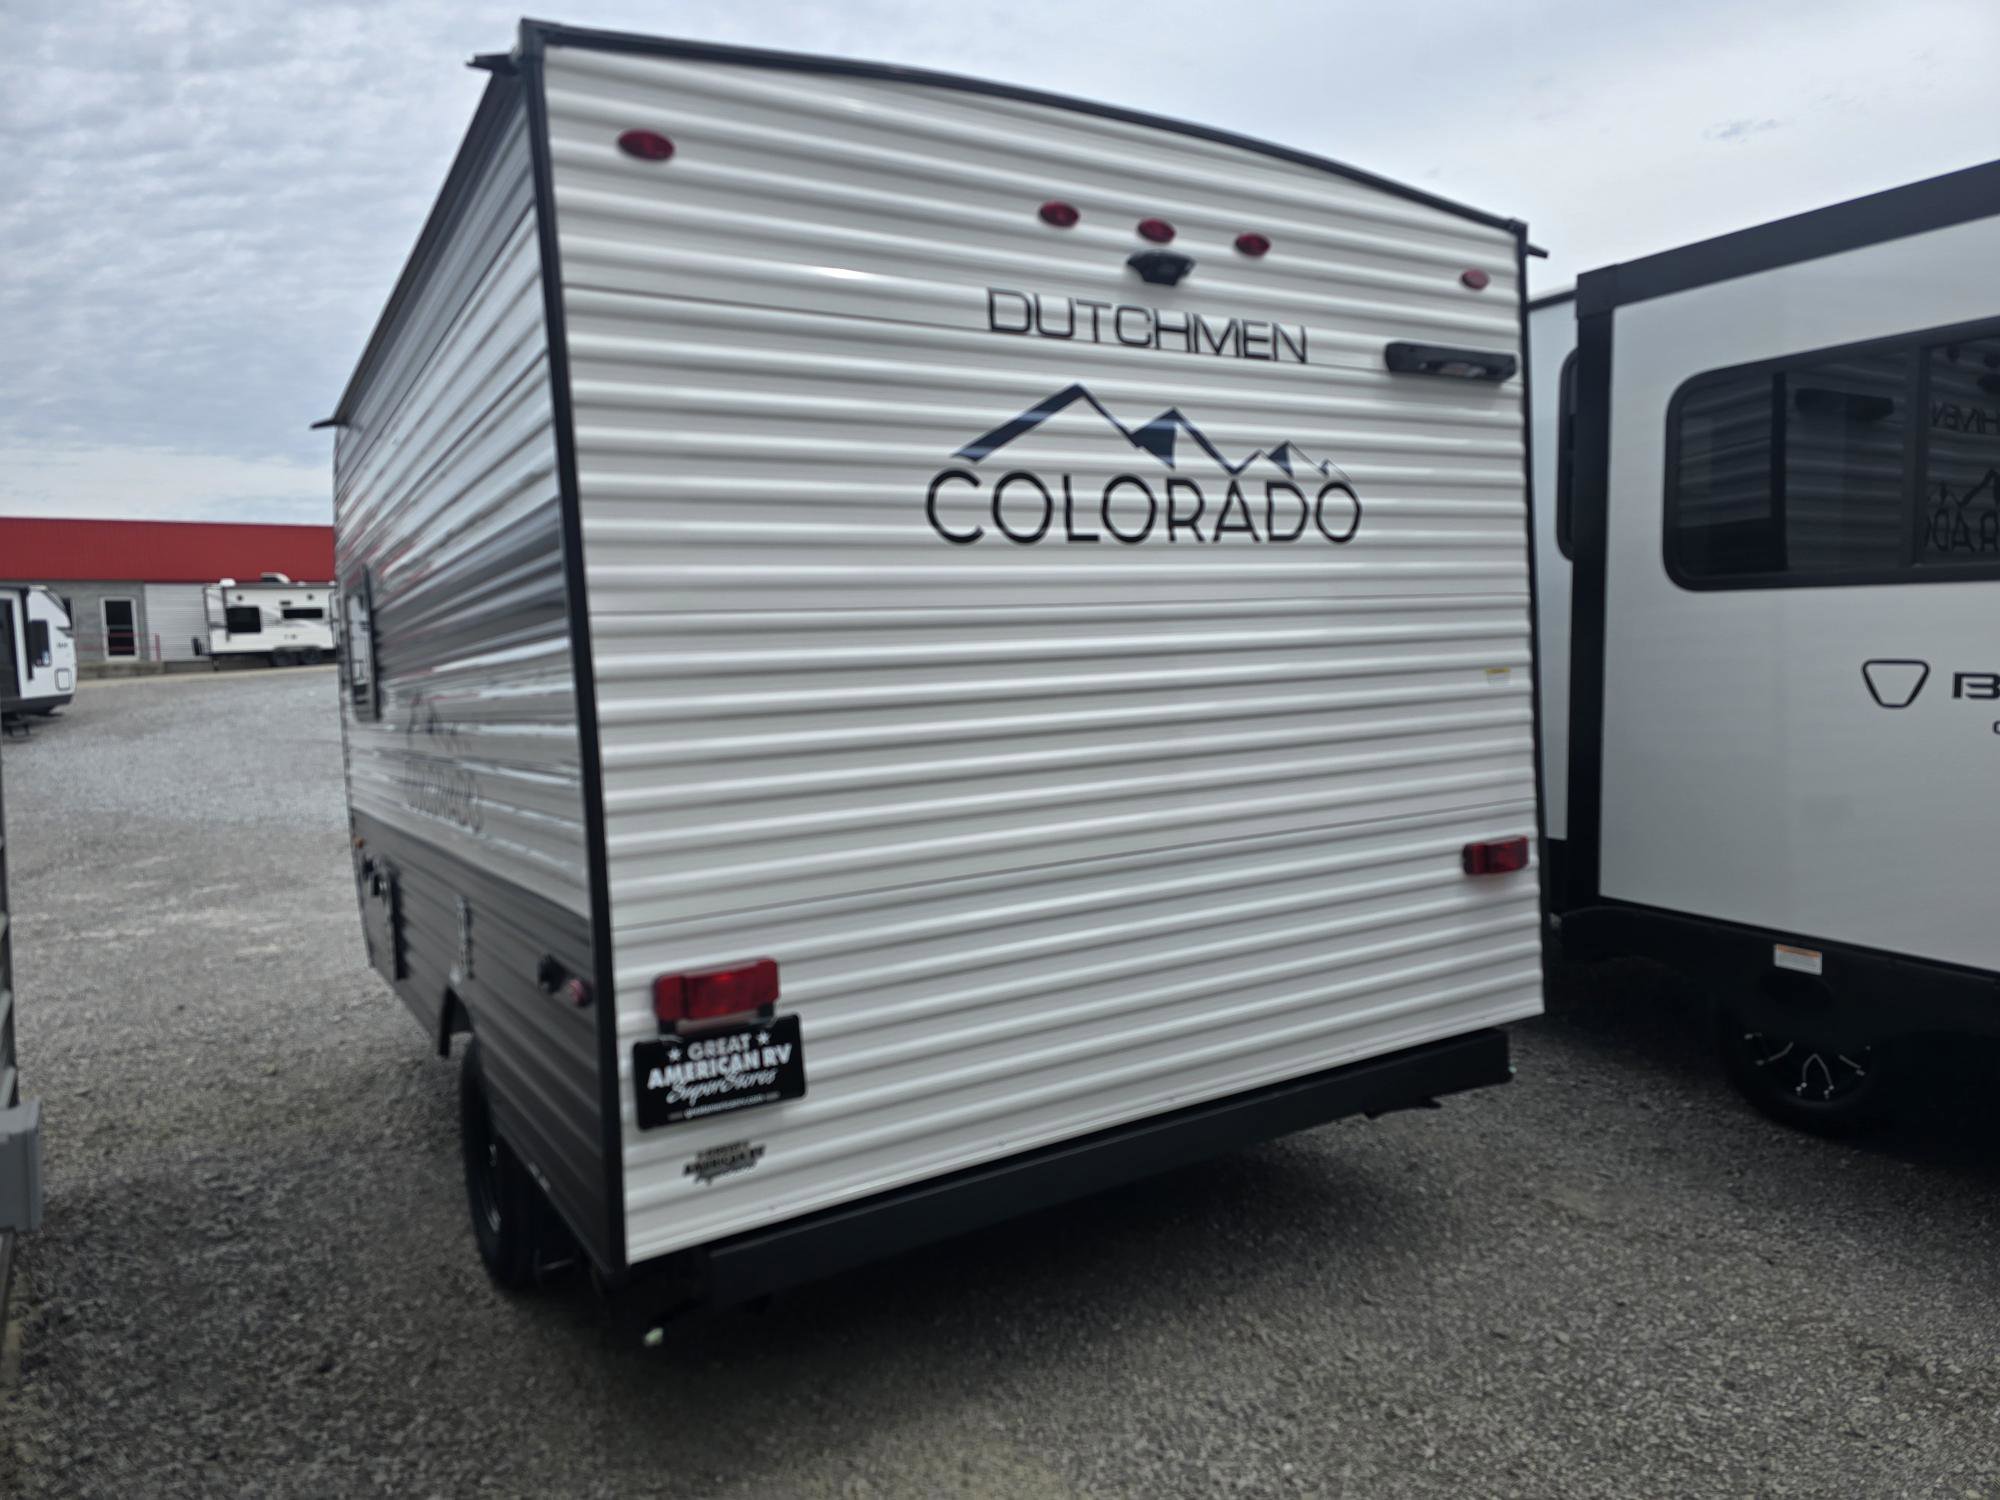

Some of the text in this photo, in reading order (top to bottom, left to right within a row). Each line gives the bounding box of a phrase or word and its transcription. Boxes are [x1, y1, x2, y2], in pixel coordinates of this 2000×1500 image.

[986, 287, 1308, 364] DUTCHMEN
[925, 468, 1363, 545] COLORADO
[647, 1042, 792, 1090] AMERICAN RV
[687, 1033, 751, 1061] GREAT
